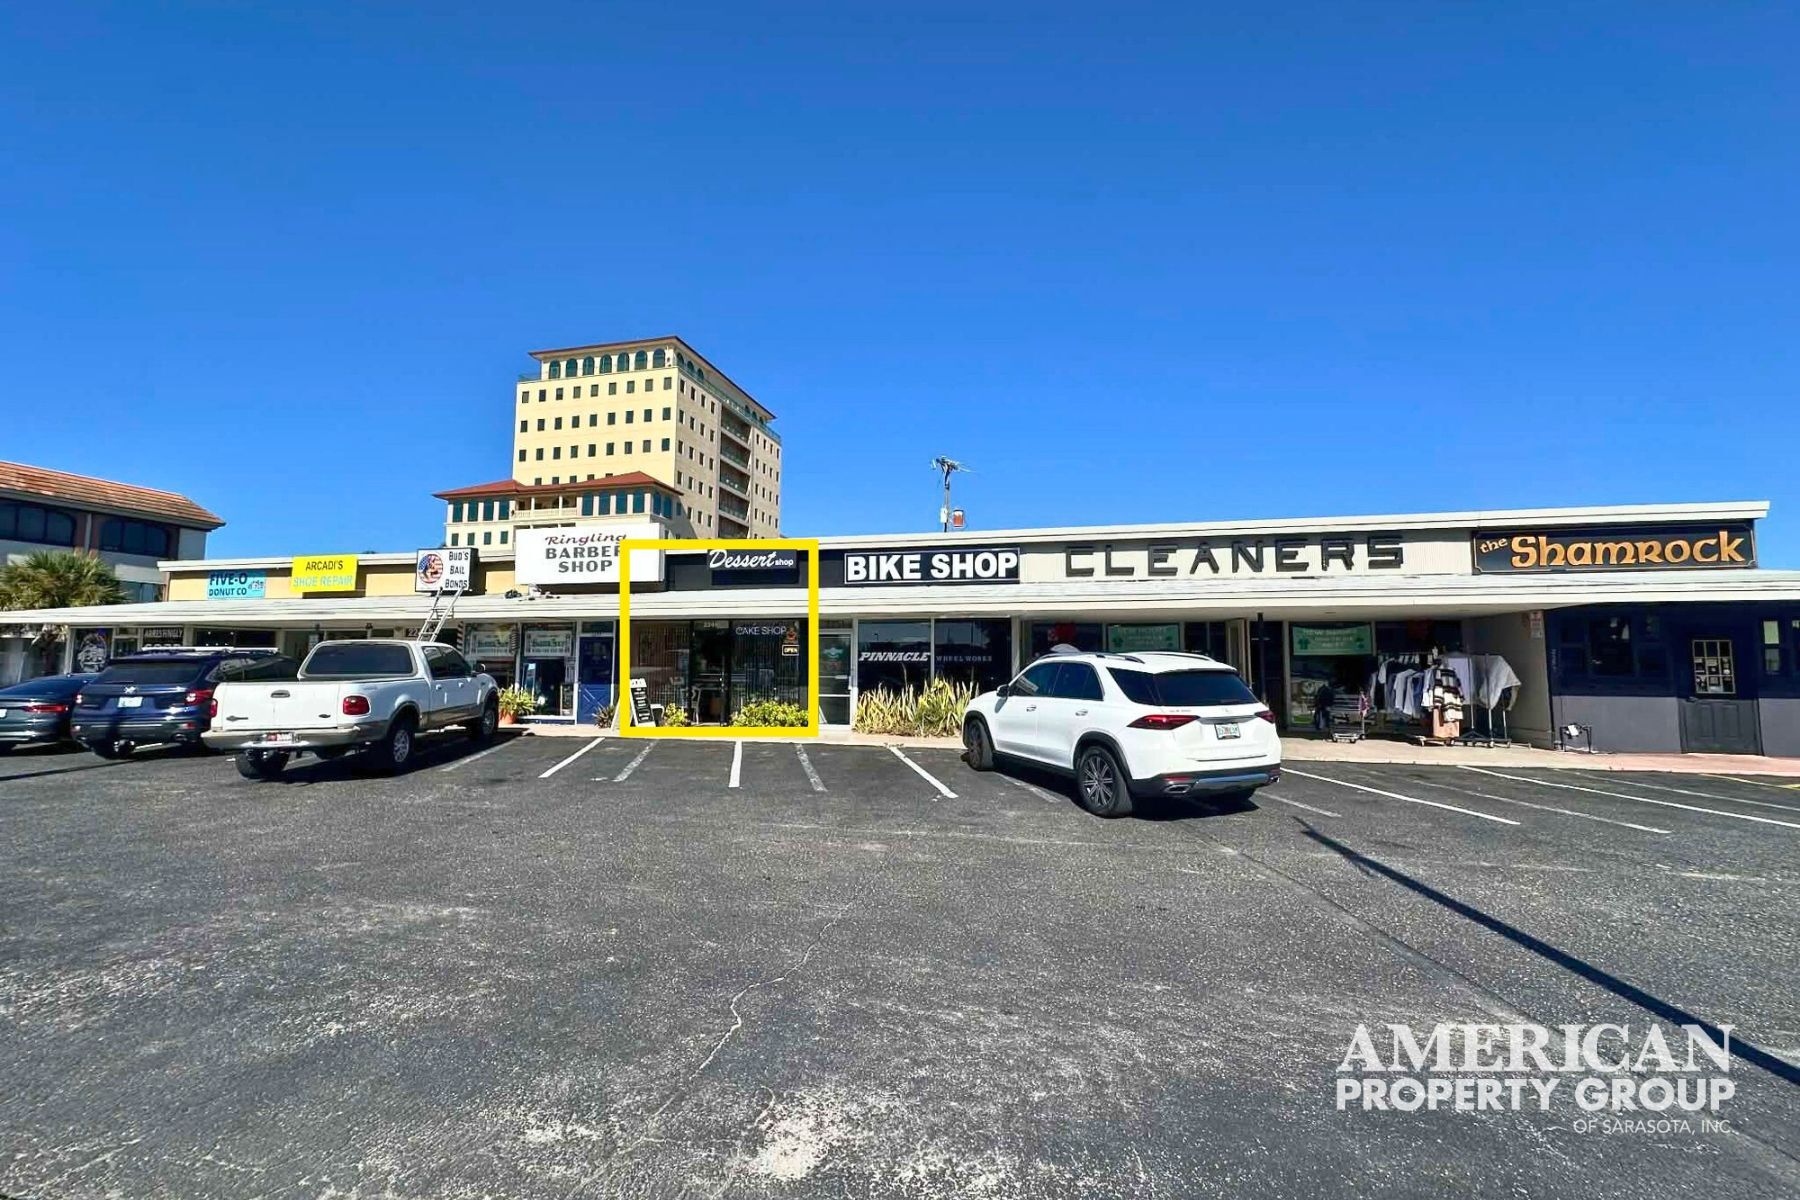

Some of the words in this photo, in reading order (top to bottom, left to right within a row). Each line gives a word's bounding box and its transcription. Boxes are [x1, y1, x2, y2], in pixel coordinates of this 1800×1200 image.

[544, 533, 627, 546] Ringling
[1480, 537, 1508, 553] the
[449, 551, 469, 561] BUD'S
[709, 549, 776, 569] Dessert
[774, 558, 794, 567] shop
[1065, 536, 1403, 577] CLEANERS
[305, 560, 344, 571] ARCADI'S
[450, 565, 465, 575] BAIL
[558, 560, 613, 573] SHOP
[847, 554, 921, 581] BIKE
[930, 551, 1018, 579] SHOP
[293, 576, 318, 588] SHOE
[320, 574, 353, 586] REPAIR
[445, 578, 468, 588] BONDS
[208, 587, 235, 597] DONUT
[236, 587, 248, 596] CO
[735, 627, 760, 635] CAKE
[761, 626, 787, 635] SHOP
[858, 652, 931, 662] PINNACLE
